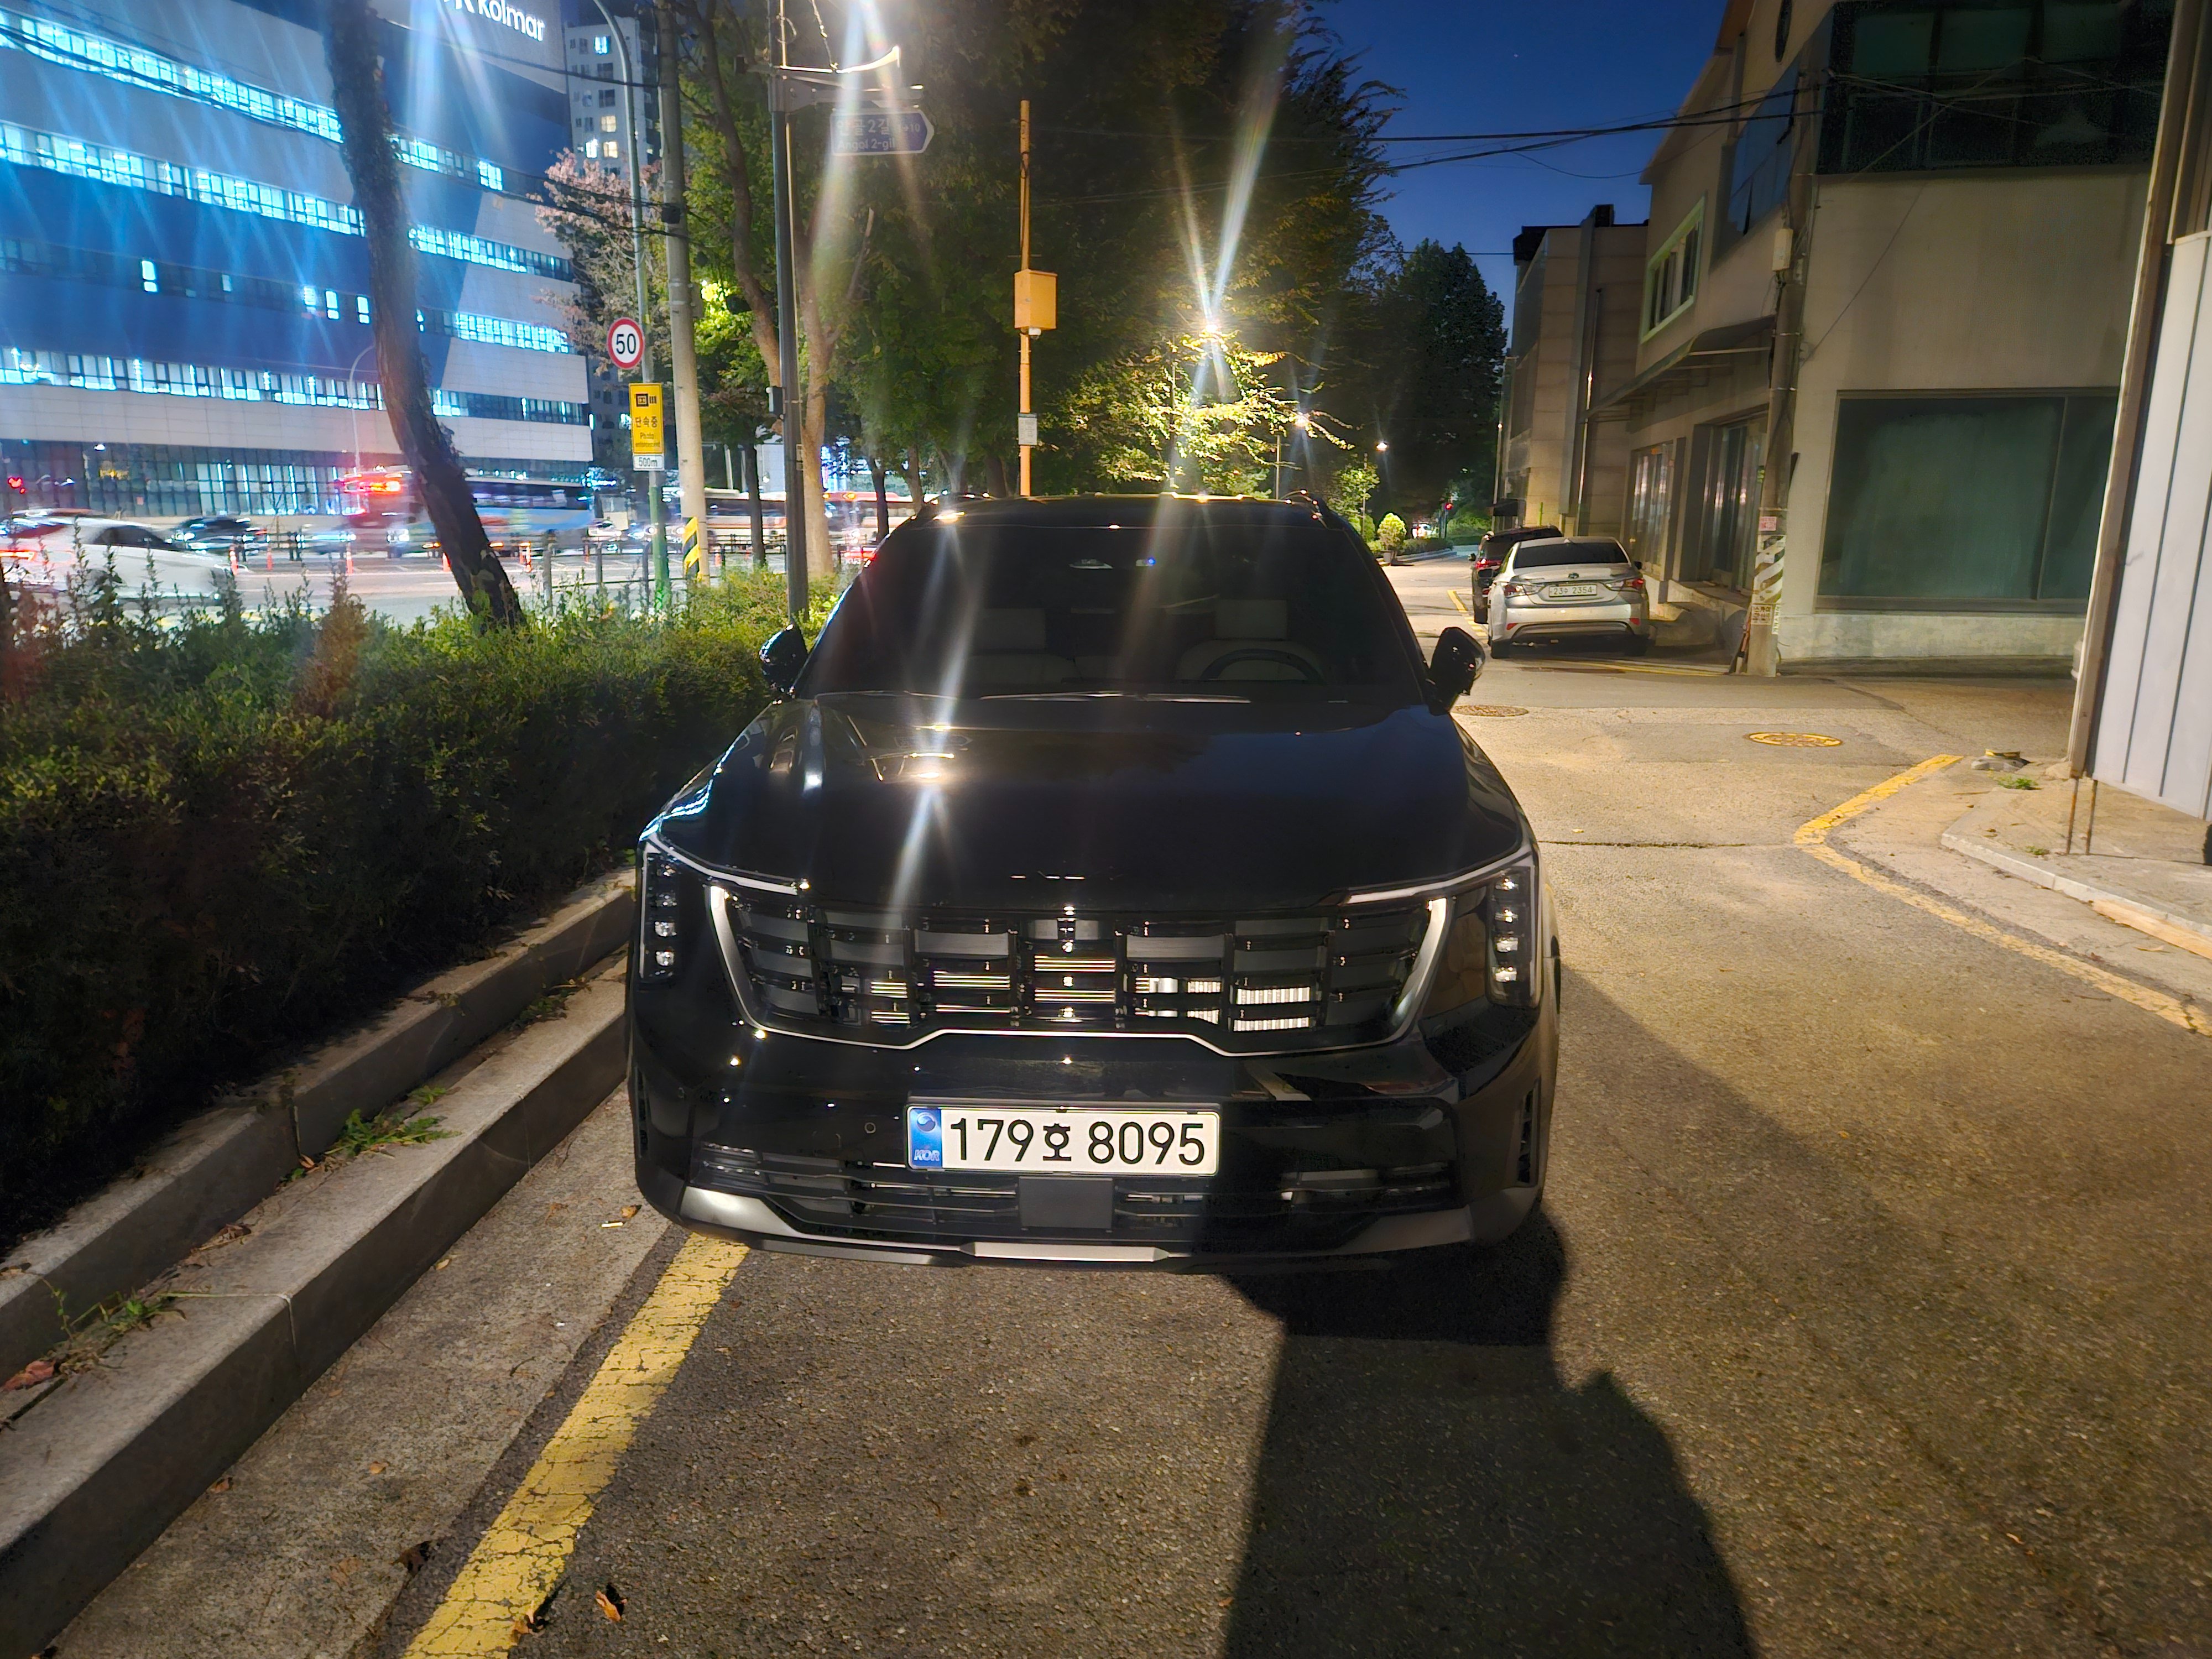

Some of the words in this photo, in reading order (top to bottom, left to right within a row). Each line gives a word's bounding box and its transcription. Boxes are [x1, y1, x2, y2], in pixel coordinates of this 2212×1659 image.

[837, 139, 868, 152] Angol
[870, 137, 895, 151] 2-gil
[615, 333, 637, 354] 50
[635, 416, 658, 427] 단속중
[639, 457, 658, 467] 500m
[950, 1117, 1072, 1162] 179호
[1088, 1121, 1205, 1166] 8095
[914, 1149, 940, 1162] KOR
